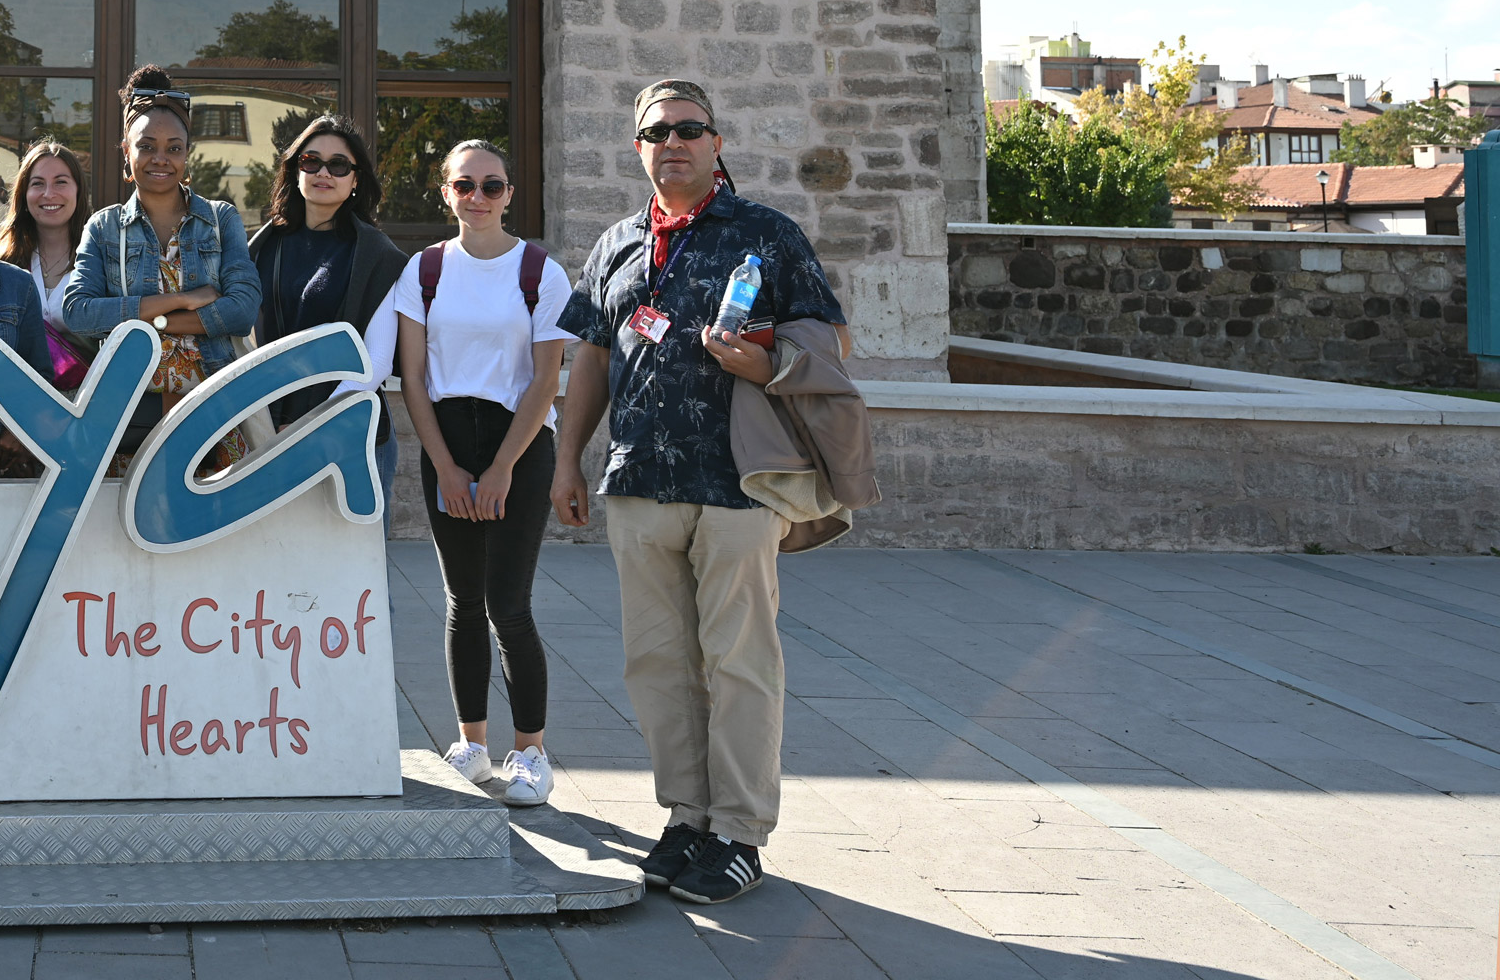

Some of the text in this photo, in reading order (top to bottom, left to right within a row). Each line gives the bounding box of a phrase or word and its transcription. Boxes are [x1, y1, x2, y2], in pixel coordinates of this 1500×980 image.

[62, 589, 375, 689] The City of
[140, 684, 310, 758] Hearts
